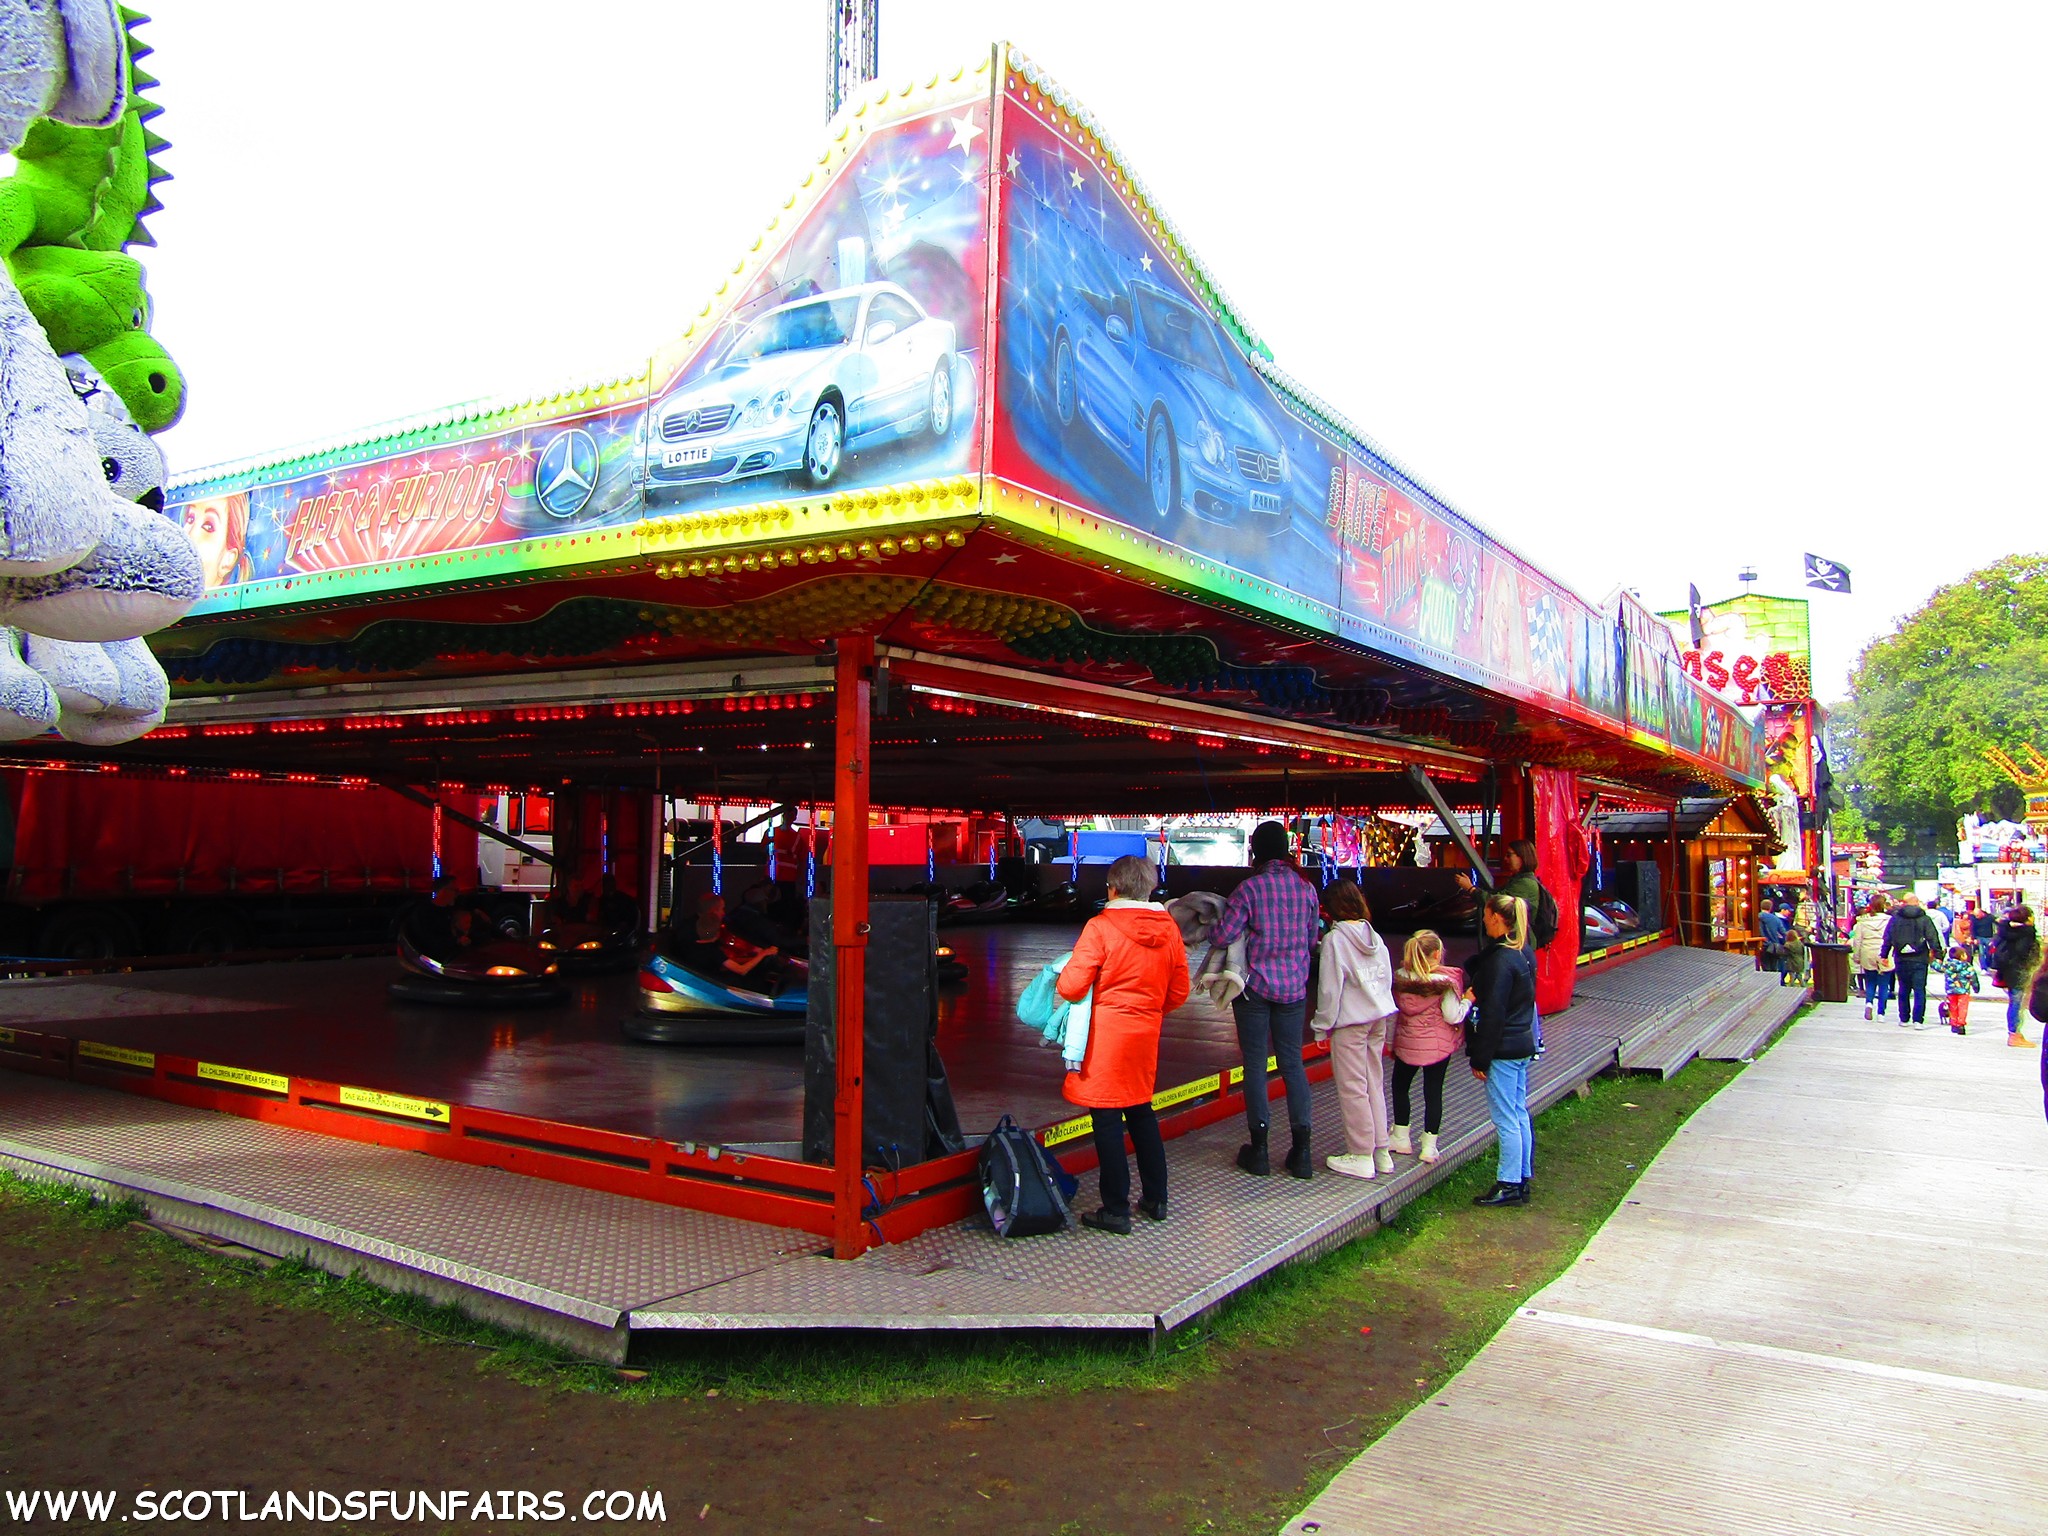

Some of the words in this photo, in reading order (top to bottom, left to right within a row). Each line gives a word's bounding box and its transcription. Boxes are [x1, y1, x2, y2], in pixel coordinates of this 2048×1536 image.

[668, 448, 708, 464] LOTTIE
[286, 488, 359, 561] FAST
[354, 483, 381, 533] &
[380, 456, 514, 527] FURIOUS
[1418, 577, 1458, 648] FUN
[1991, 868, 2041, 876] CHIPS
[200, 1066, 208, 1074] ALL
[209, 1067, 231, 1078] CHILDREN
[231, 1071, 244, 1080] MUST
[244, 1073, 258, 1083] WEAR
[258, 1076, 270, 1085] SEAT
[270, 1079, 286, 1089] BELTS
[344, 1092, 356, 1101] ONE
[356, 1094, 368, 1103] WAY
[368, 1095, 391, 1108] AROUND
[391, 1100, 402, 1110] THE
[403, 1103, 422, 1113] TRACK
[1158, 1095, 1178, 1105] CHILDREN
[1177, 1090, 1188, 1098] MUST
[1187, 1085, 1199, 1094] WEAR
[1199, 1082, 1208, 1091] SEAT
[1063, 1124, 1080, 1136] CLEAR
[1080, 1120, 1093, 1131] WHIL
